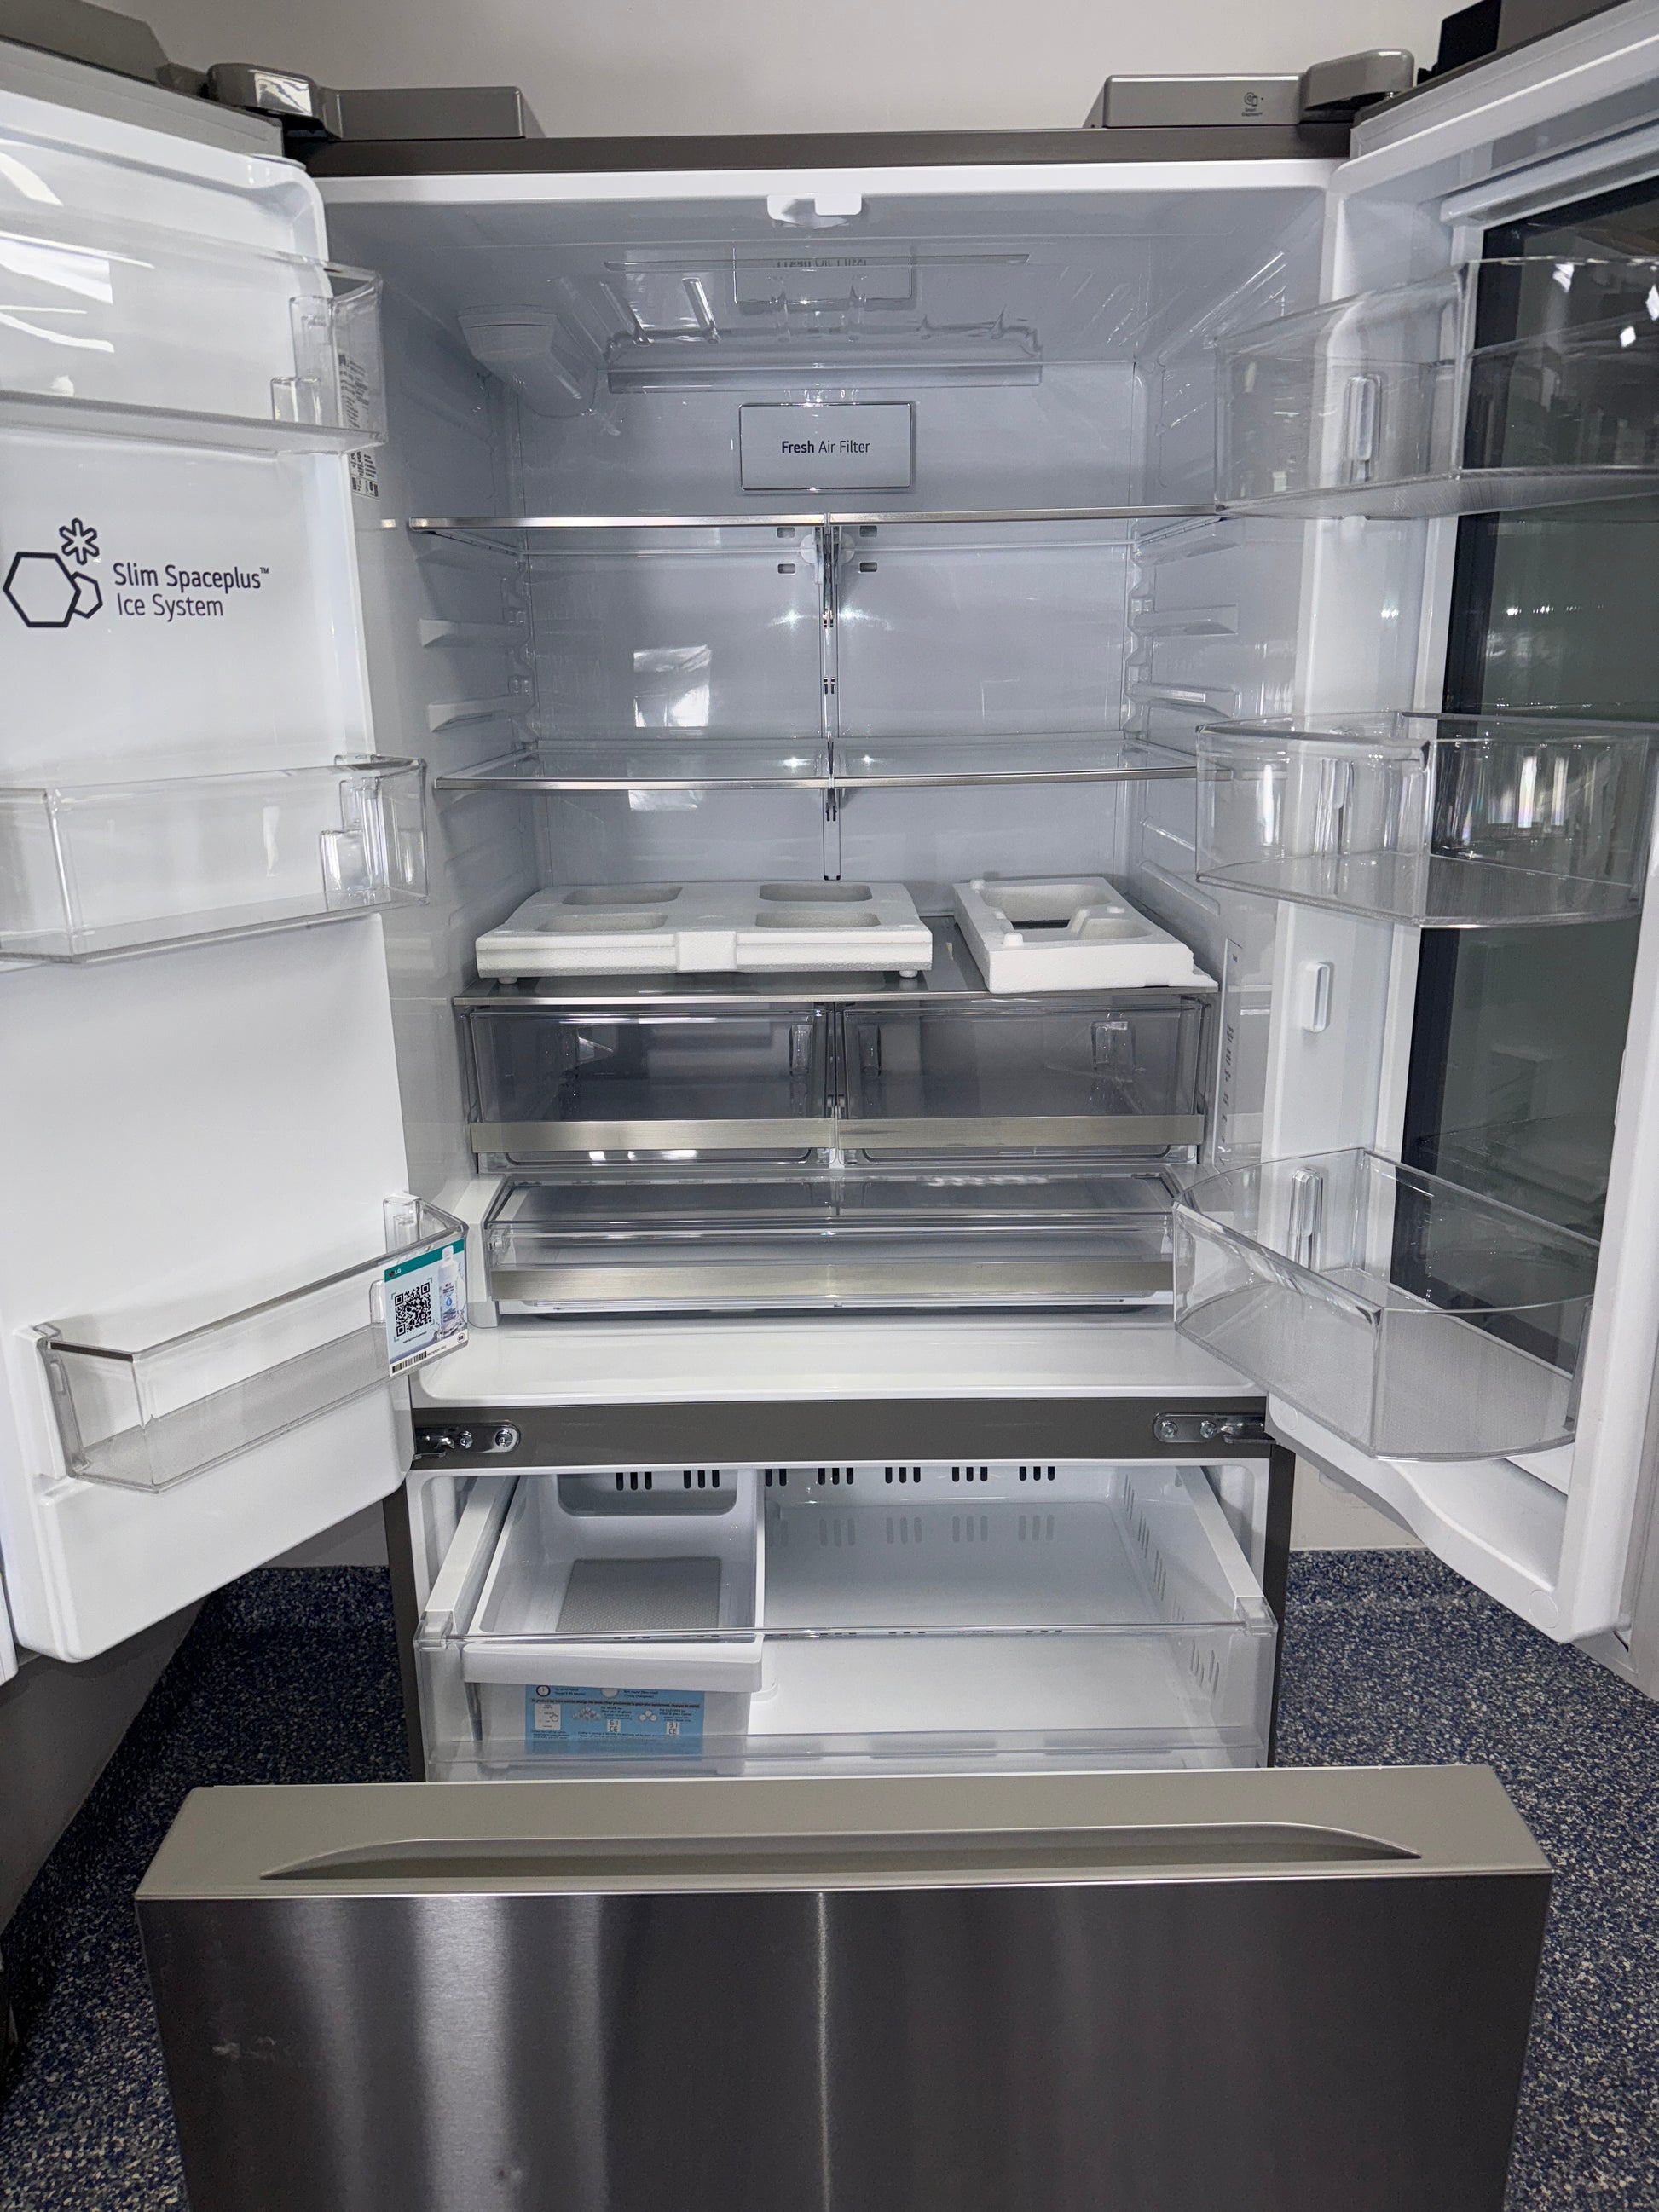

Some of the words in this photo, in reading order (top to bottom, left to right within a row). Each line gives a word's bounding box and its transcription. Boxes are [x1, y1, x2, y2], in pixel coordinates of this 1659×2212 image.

[782, 440, 814, 453] Fresh
[818, 440, 836, 453] Air
[839, 440, 870, 453] Filter
[113, 563, 159, 586] Slim
[117, 592, 145, 615] Ice
[152, 594, 224, 622] System
